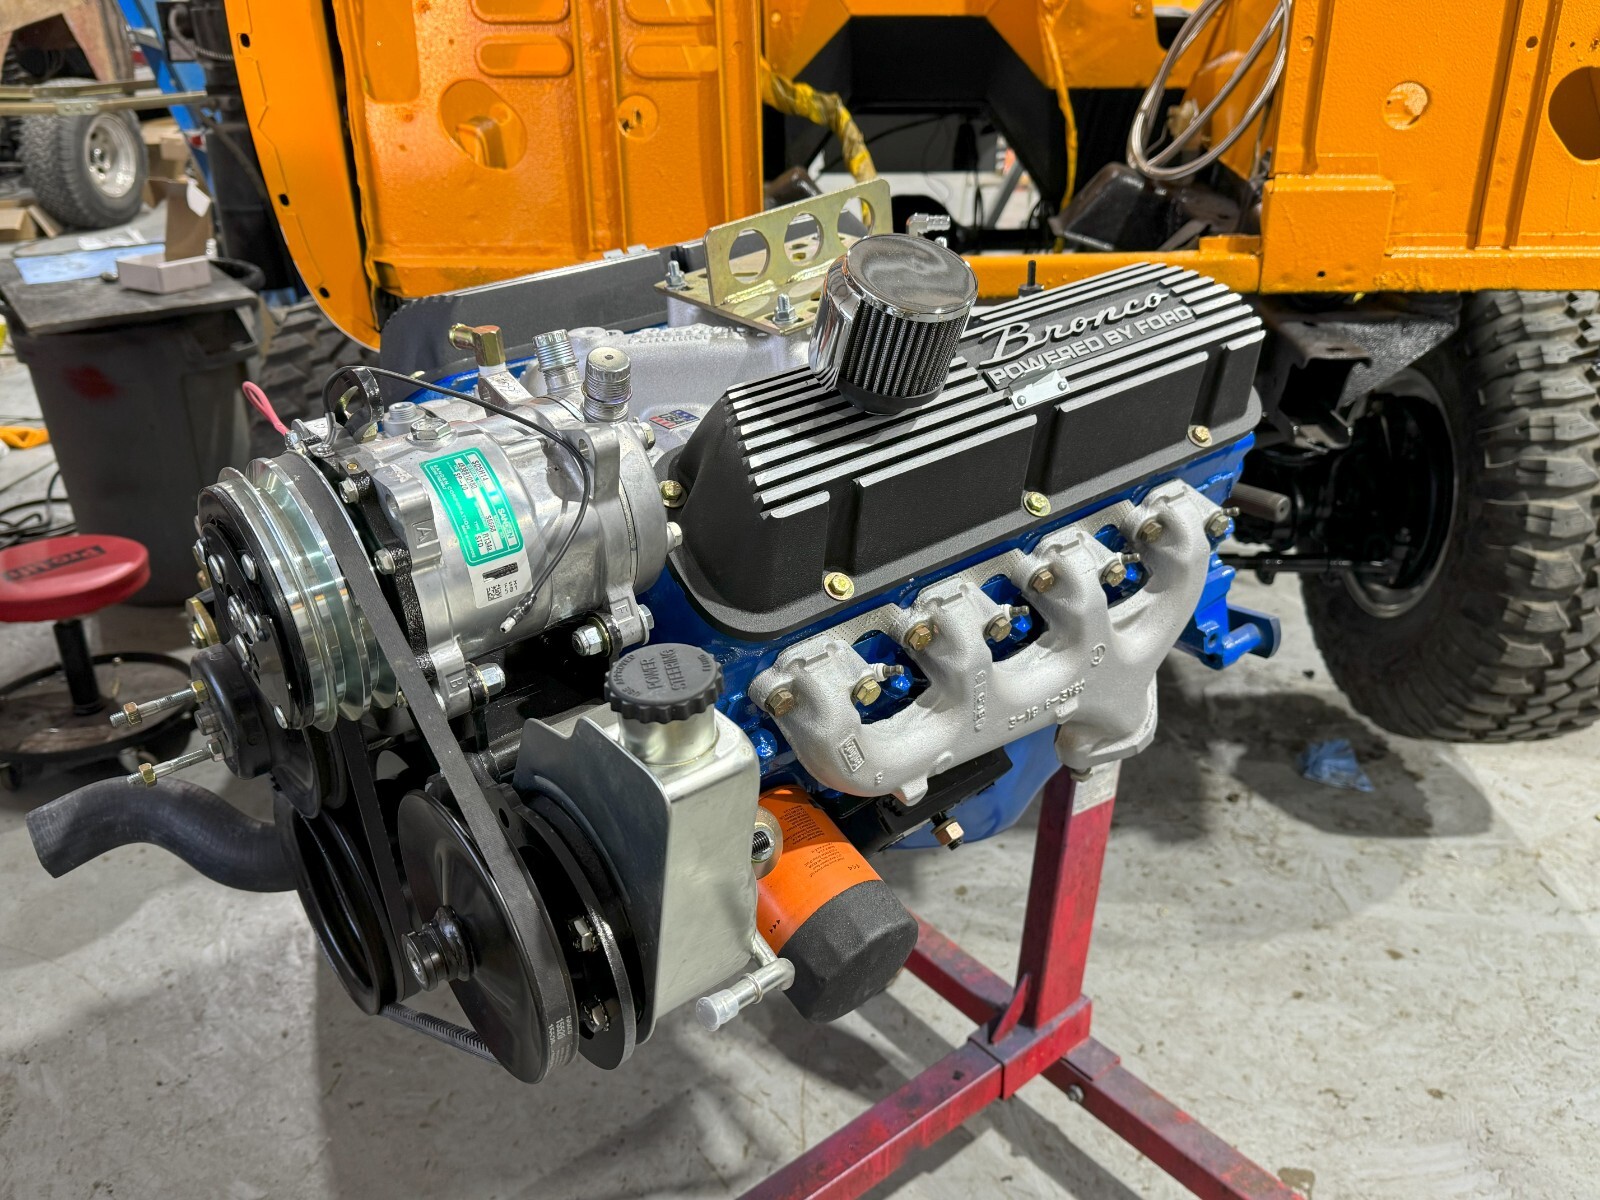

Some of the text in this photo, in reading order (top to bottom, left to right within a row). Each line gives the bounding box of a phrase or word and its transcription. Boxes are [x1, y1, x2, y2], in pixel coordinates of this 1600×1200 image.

[978, 291, 1169, 369] Bronco
[988, 305, 1193, 385] POWERED BY FORD
[434, 464, 470, 530] SANDEN CORPORATION
[416, 527, 433, 542] A
[498, 507, 514, 539] SANDEN
[475, 535, 484, 548] STD
[483, 533, 494, 551] R134a
[450, 676, 464, 688] B
[613, 653, 640, 697] USE APPROVED
[640, 657, 663, 690] POWER
[660, 648, 687, 690] STEERING
